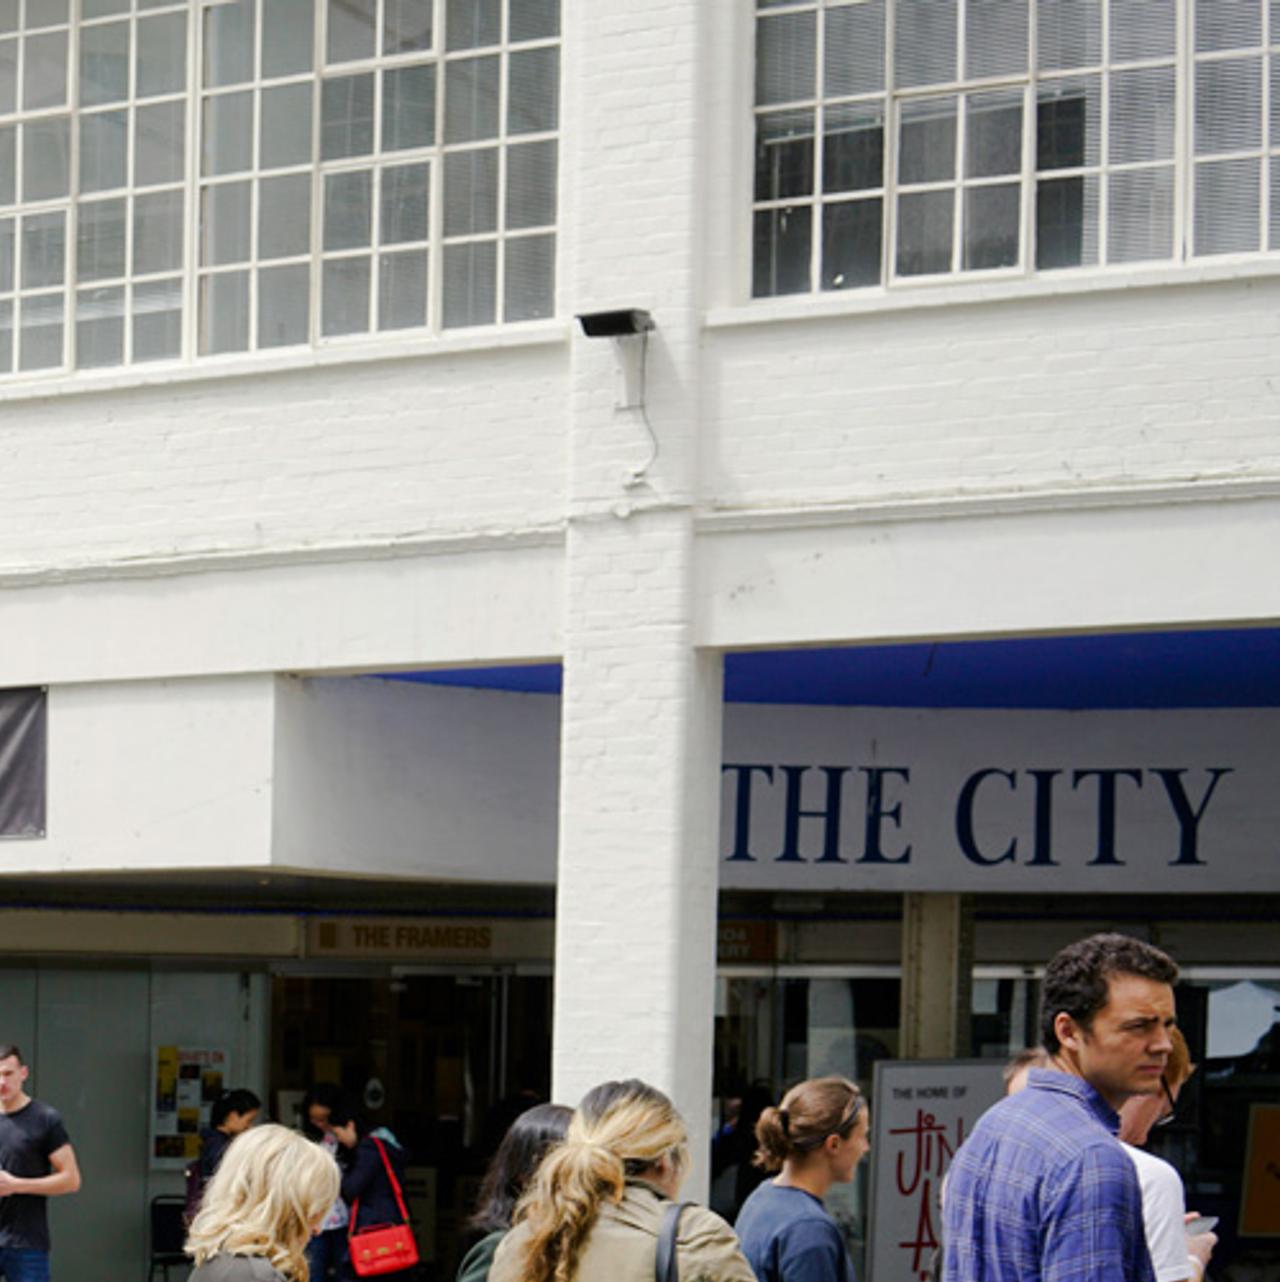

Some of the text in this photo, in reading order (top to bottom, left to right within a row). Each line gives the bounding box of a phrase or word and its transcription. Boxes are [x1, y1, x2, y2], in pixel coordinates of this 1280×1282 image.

[721, 763, 1236, 867] THE CITY
[352, 924, 493, 949] THE FRAMERS
[892, 1085, 968, 1099] THE HOME OF
